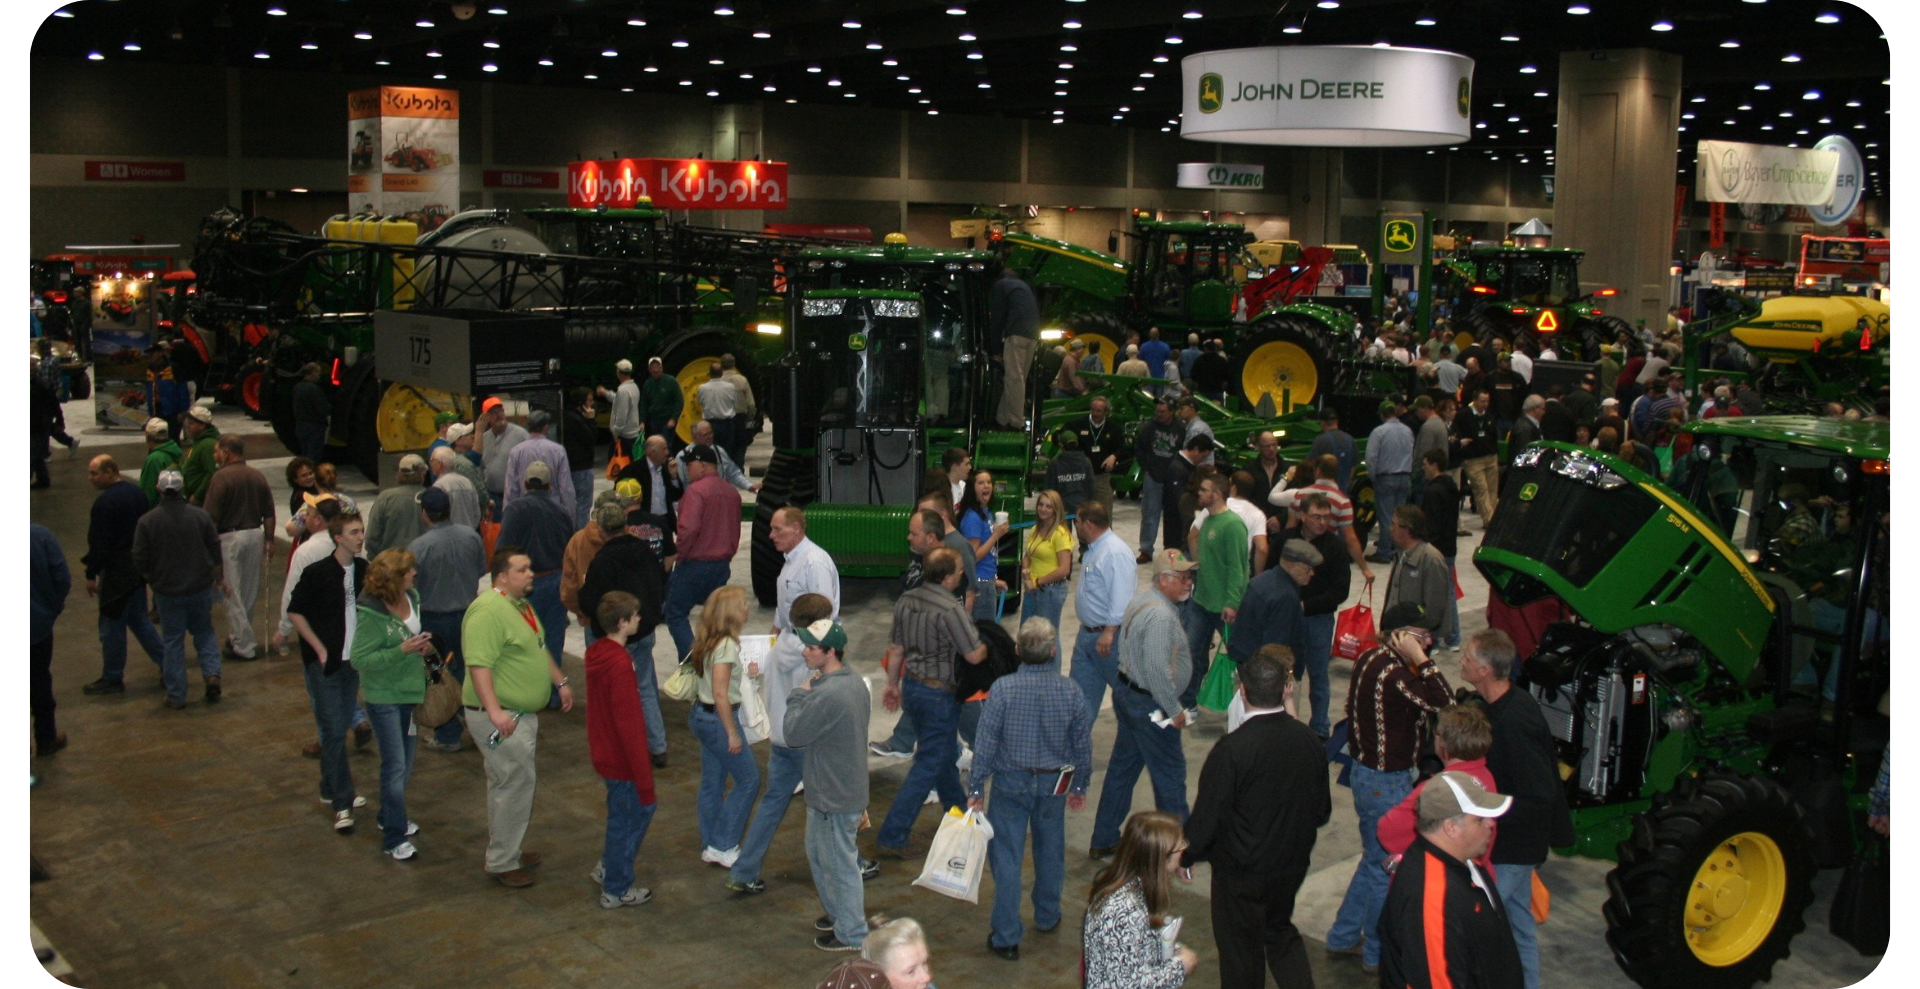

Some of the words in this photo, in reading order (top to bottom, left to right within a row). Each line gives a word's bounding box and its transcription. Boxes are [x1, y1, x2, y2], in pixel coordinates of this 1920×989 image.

[387, 93, 451, 111] Kubota
[1231, 81, 1293, 102] JOHN
[1300, 79, 1384, 99] DEERE
[130, 166, 171, 176] Women
[524, 176, 542, 185] Men
[1744, 161, 1771, 186] Bayer
[1772, 162, 1828, 188] CropScience
[572, 169, 647, 203] Kubota
[661, 167, 781, 203] Kubota
[409, 336, 431, 366] 175
